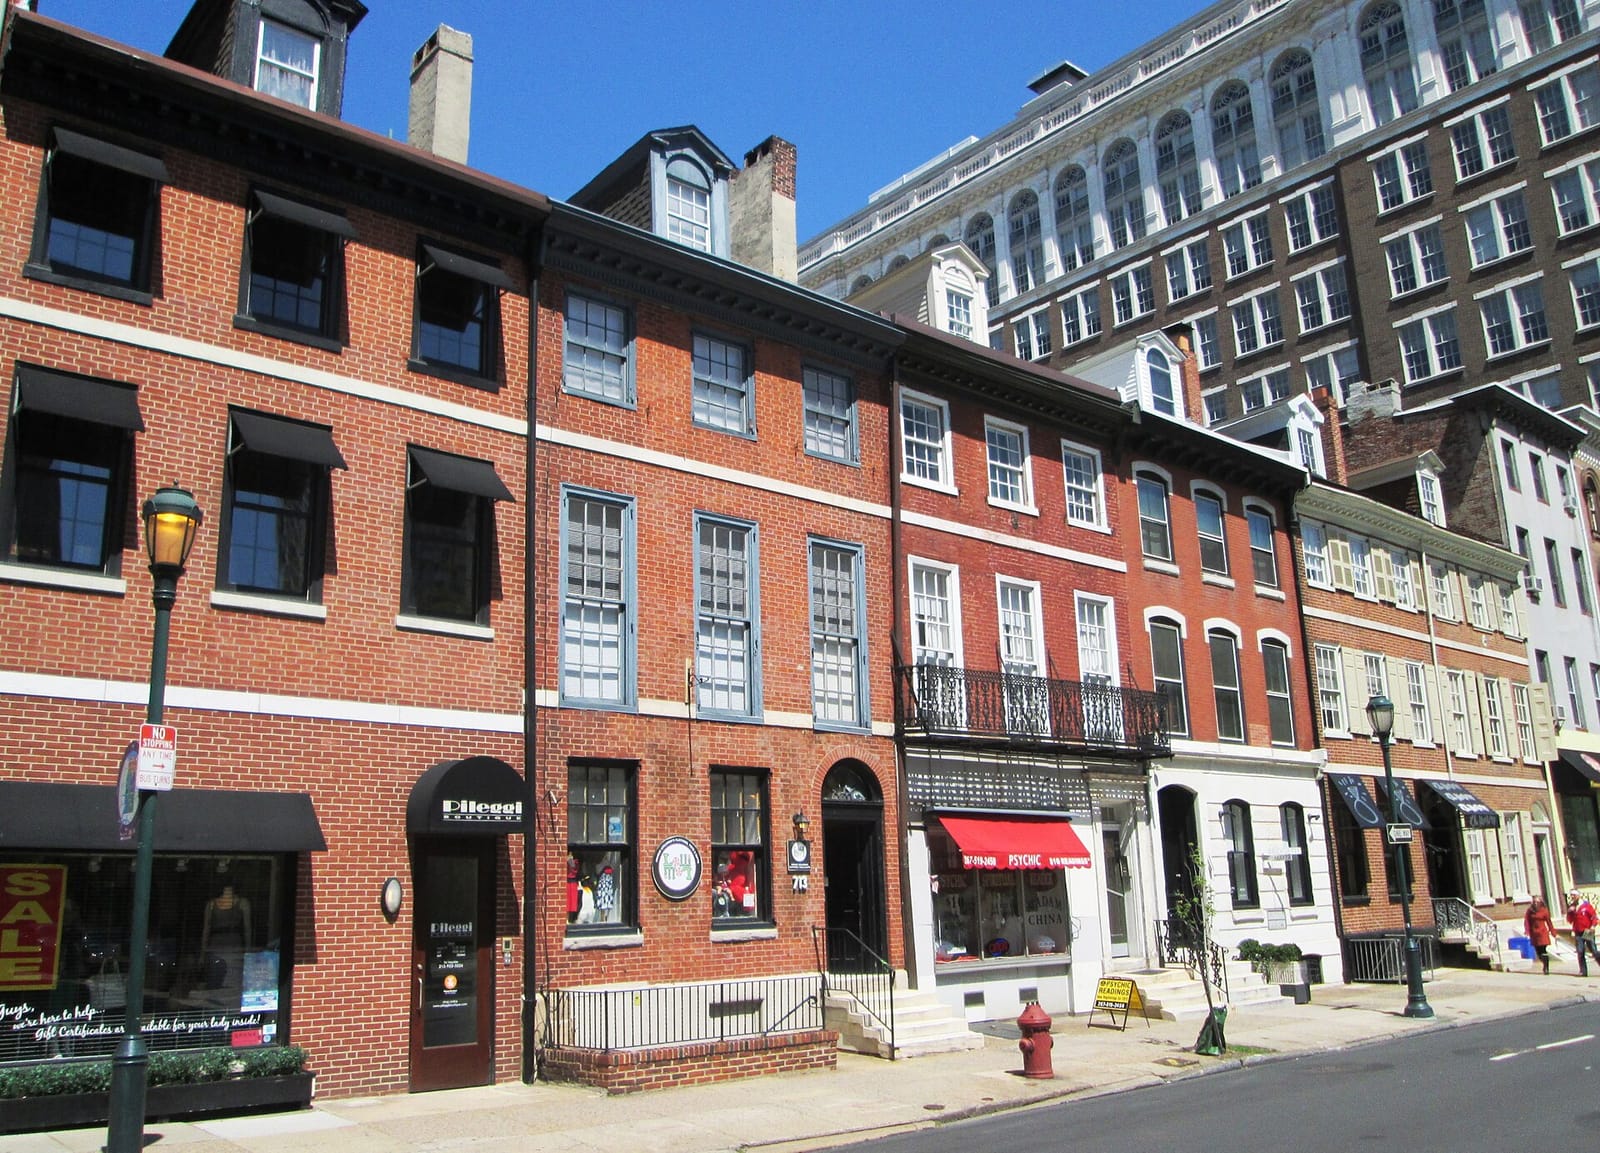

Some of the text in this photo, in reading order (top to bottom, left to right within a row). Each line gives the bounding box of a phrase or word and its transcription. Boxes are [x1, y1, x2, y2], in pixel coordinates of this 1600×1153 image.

[152, 727, 166, 739] NO
[142, 738, 173, 749] STOPPING
[143, 751, 173, 760] ANY TIME
[443, 800, 522, 814] Pileggi
[1008, 854, 1041, 866] PSYCHIC
[792, 875, 807, 889] 713
[0, 872, 51, 981] SALE
[1028, 914, 1062, 926] CHINA
[40, 1012, 62, 1025] here
[62, 1009, 72, 1020] to
[35, 1026, 57, 1040] Gift
[59, 1023, 112, 1038] Certificates
[172, 1017, 186, 1032] for
[188, 1020, 208, 1033] your
[210, 1014, 230, 1031] lady
[231, 1014, 261, 1026] inside!
